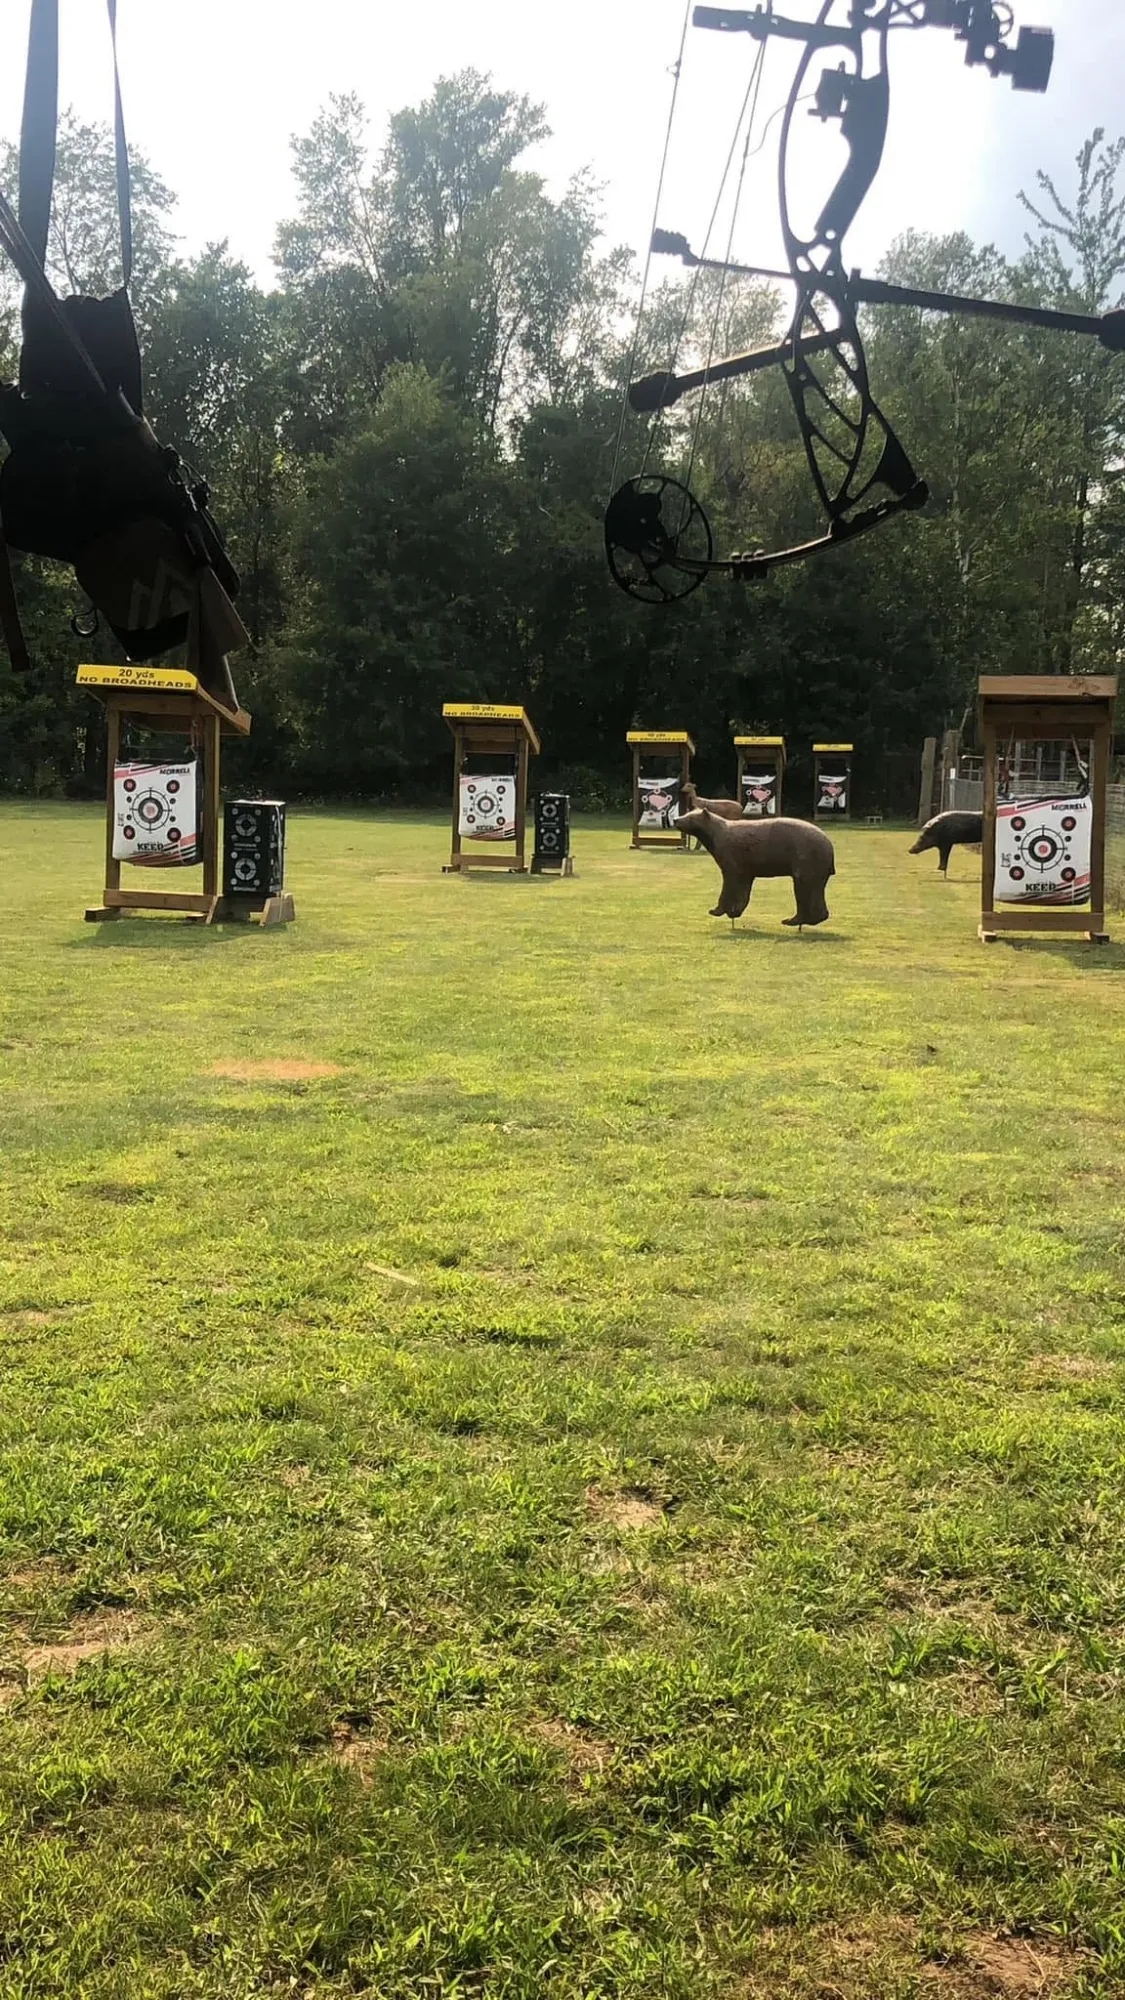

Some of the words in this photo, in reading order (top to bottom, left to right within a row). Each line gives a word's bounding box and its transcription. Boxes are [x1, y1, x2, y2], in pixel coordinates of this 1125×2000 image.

[118, 668, 133, 677] 20
[135, 670, 155, 679] yds
[102, 677, 192, 688] BROADHEADS
[1051, 802, 1087, 811] MORRELL
